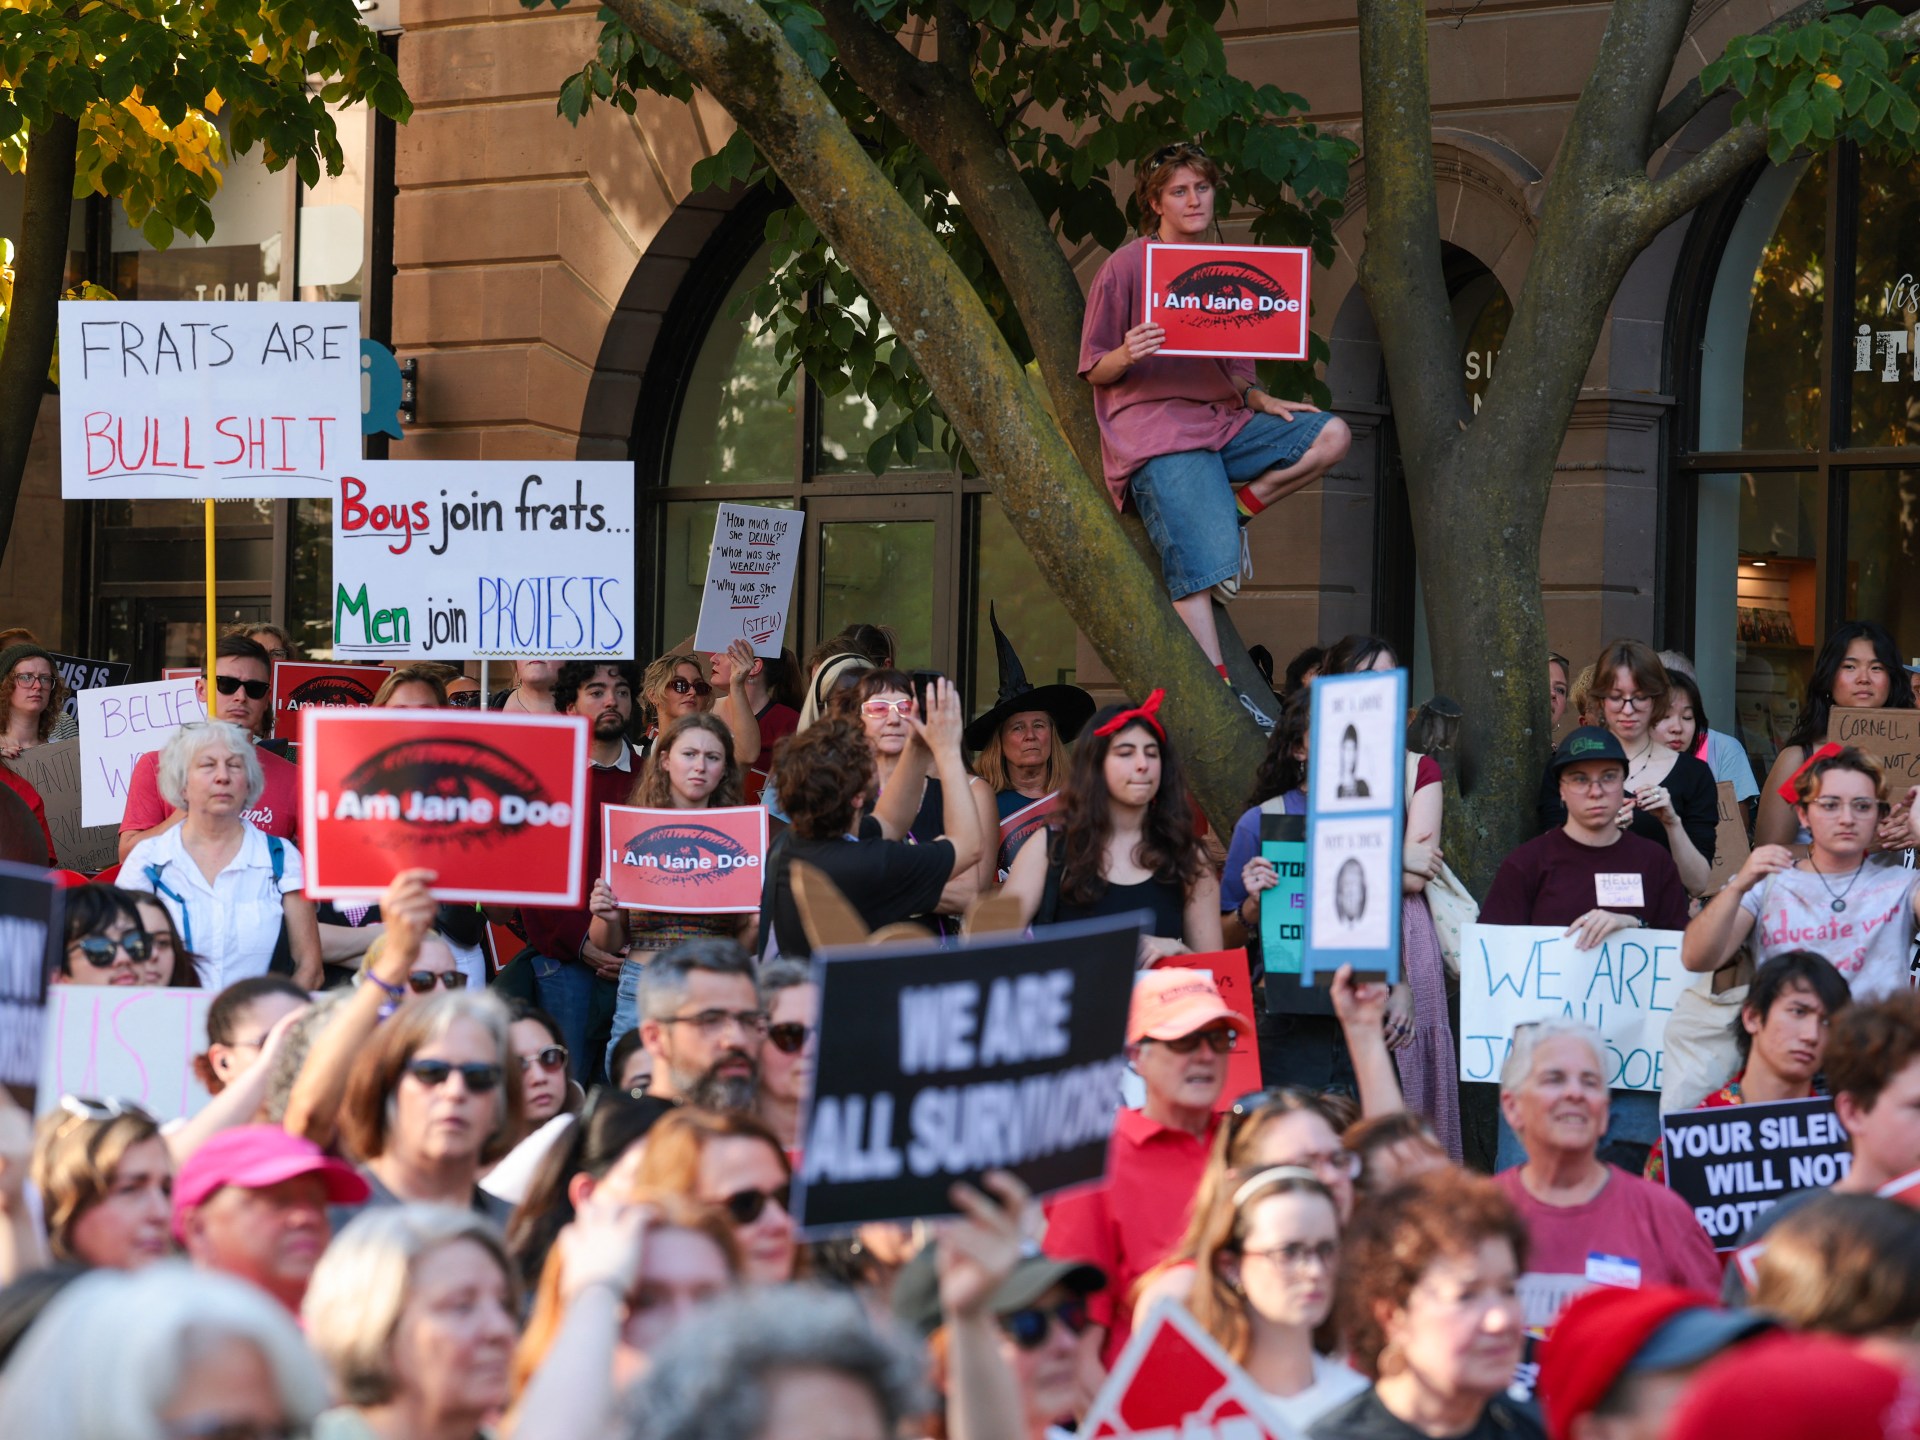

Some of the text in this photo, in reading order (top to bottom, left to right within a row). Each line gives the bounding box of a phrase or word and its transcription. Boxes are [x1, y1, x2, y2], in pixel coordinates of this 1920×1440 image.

[1152, 292, 1301, 313] I Am Jane Doe
[81, 321, 348, 380] FRATS ARE
[84, 411, 337, 476] BULLSHIT
[340, 474, 631, 556] Boys join frats...
[748, 518, 769, 531] much
[774, 521, 788, 533] did
[729, 530, 785, 544] she DRINK?"
[729, 561, 781, 574] WEARING?"
[746, 550, 763, 560] was
[766, 551, 781, 562] she
[740, 582, 756, 592] was
[760, 583, 777, 594] she
[334, 576, 624, 652] Men join PROTESTS
[742, 612, 782, 637] (STFU)
[56, 660, 110, 691] HIS IS
[277, 698, 283, 710] I
[286, 699, 316, 710] Am
[1839, 714, 1909, 742] CORNELL,
[1883, 752, 1911, 770] NOT
[239, 806, 273, 824] an's
[316, 790, 573, 828] I Am Jane Doe
[612, 849, 760, 870] I Am Jane Doe
[1479, 937, 1678, 1012] WE ARE
[899, 967, 1076, 1076] WE ARE
[802, 1090, 903, 1186] ALL
[1664, 1111, 1849, 1160] YOUR SILEN
[1704, 1152, 1855, 1197] WILL NOT
